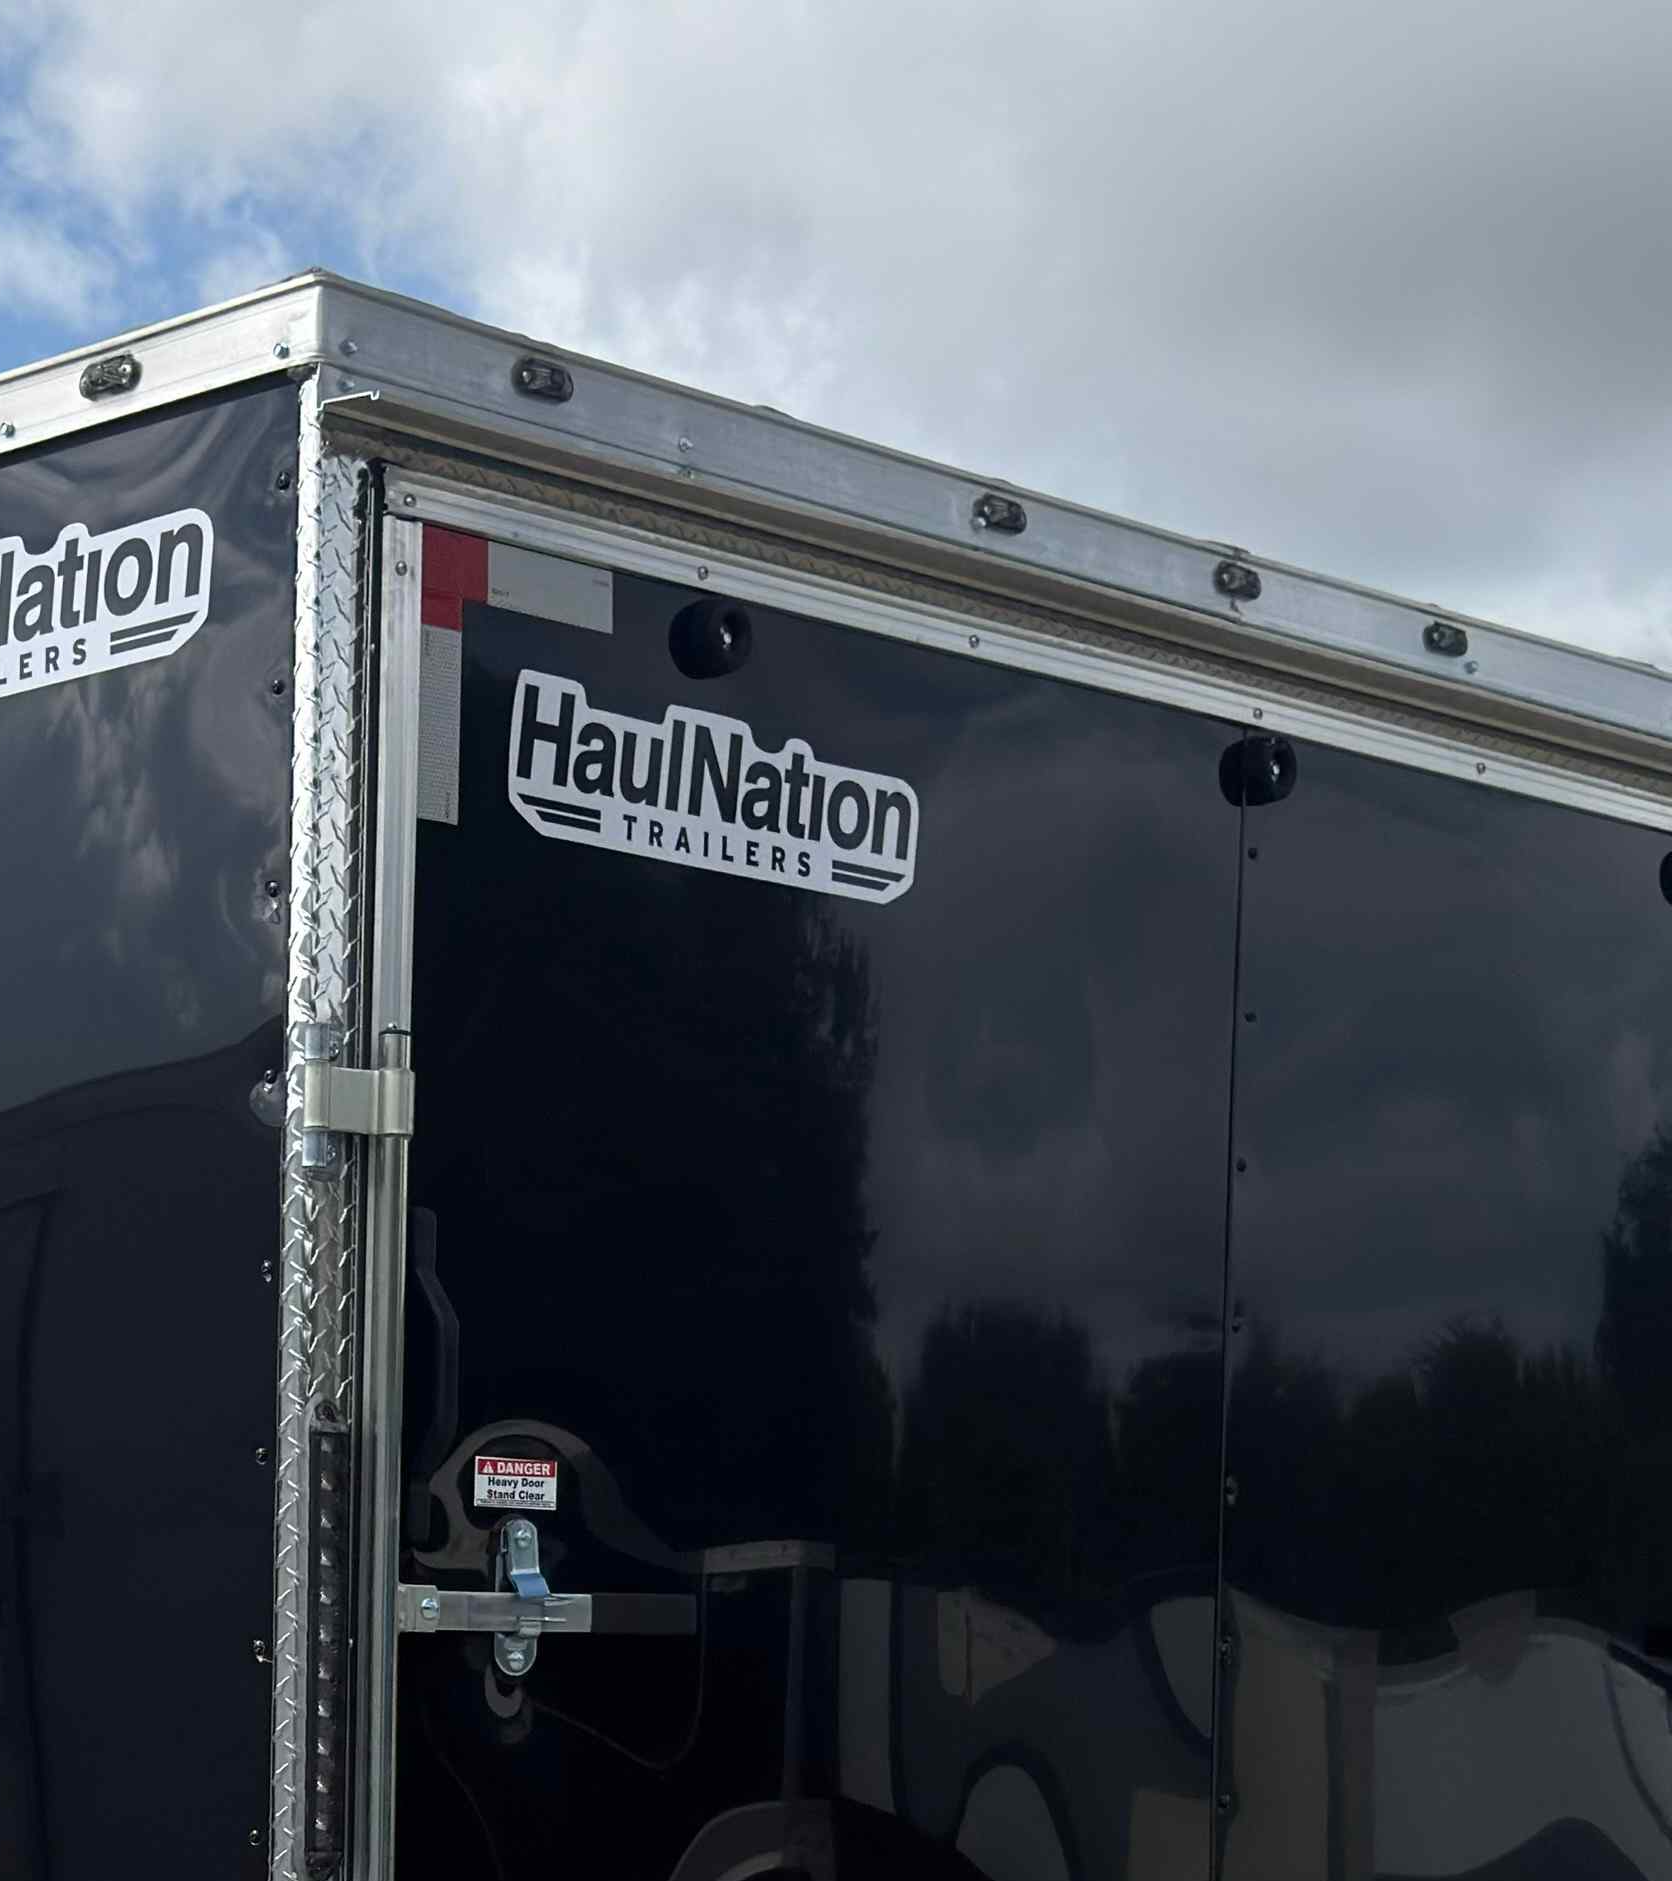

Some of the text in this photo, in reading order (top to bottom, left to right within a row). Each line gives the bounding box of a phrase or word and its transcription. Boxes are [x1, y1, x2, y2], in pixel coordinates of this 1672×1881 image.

[516, 684, 912, 860] HaulNation
[623, 813, 811, 877] TRAILERS
[497, 1461, 551, 1476] DANGER
[488, 1476, 545, 1489] Heavy Door
[487, 1489, 545, 1501] Stand Clear
